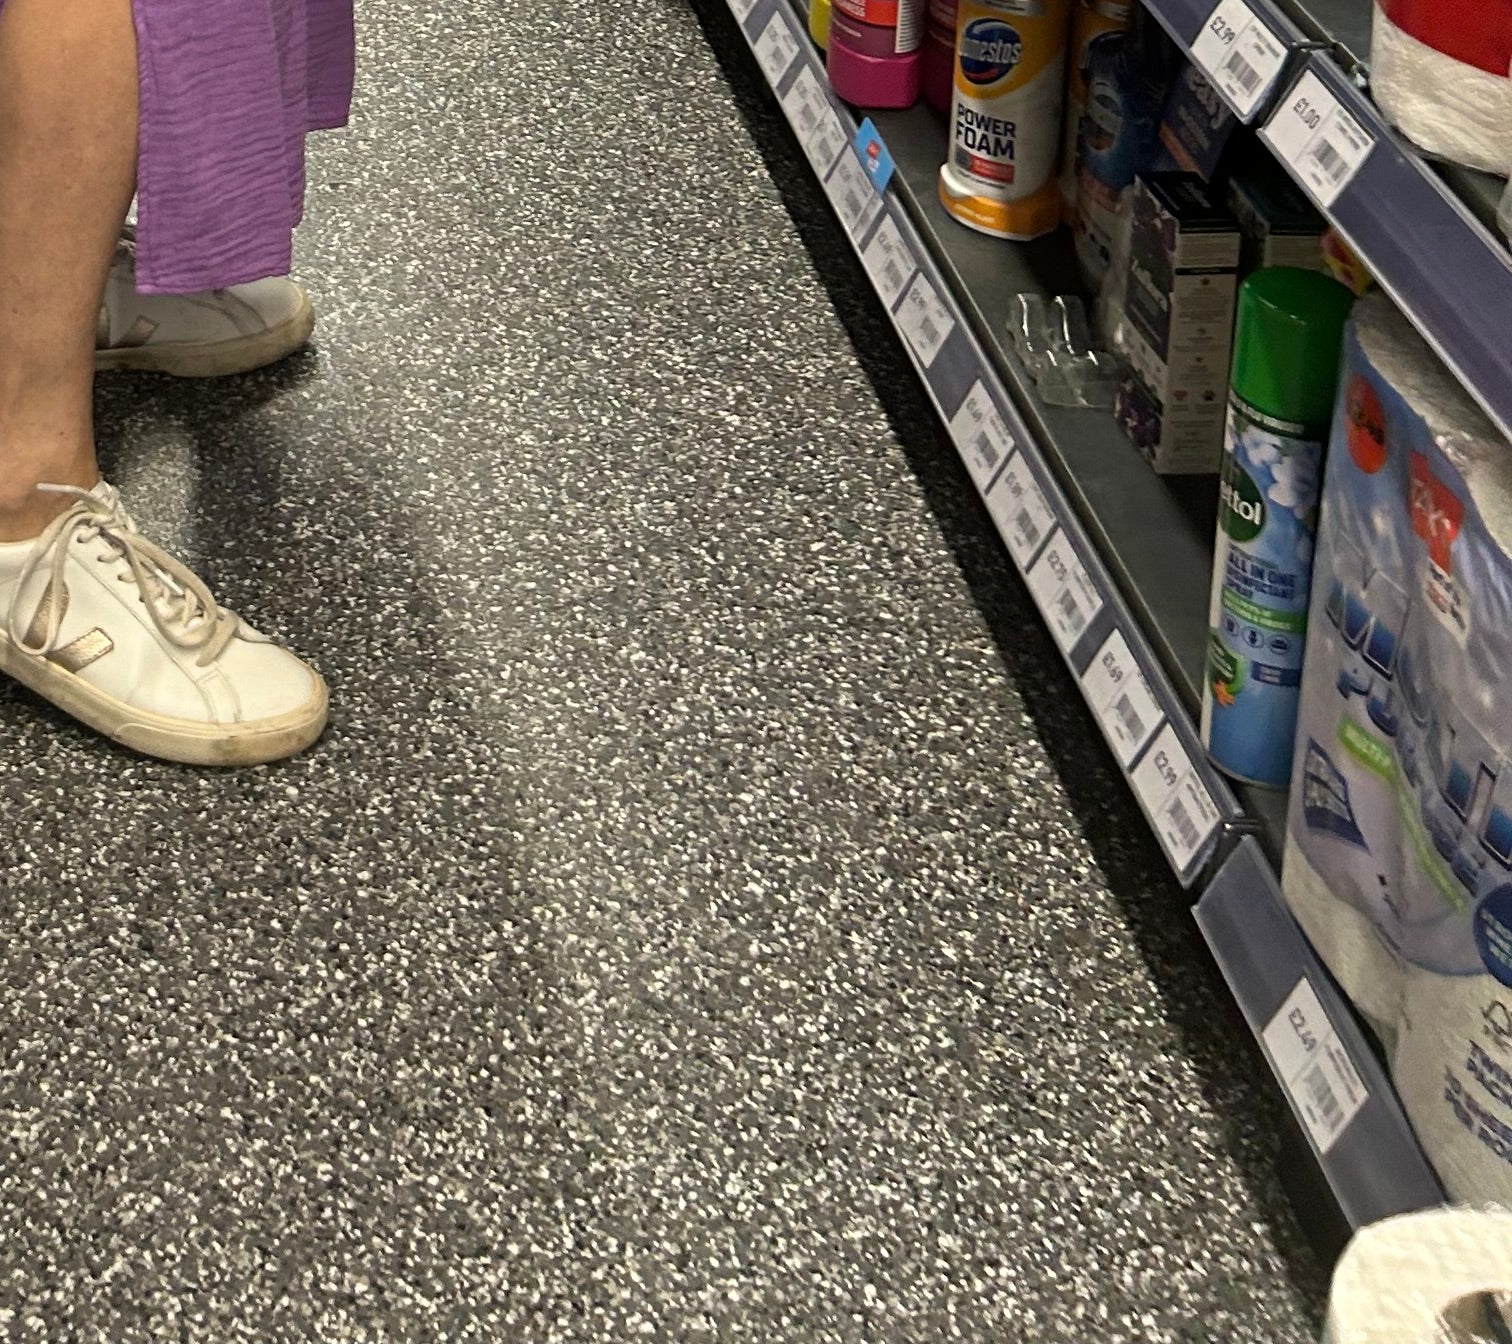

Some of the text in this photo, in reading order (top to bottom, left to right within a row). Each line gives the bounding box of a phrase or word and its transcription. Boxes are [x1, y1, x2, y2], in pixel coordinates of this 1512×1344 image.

[1208, 14, 1237, 47] £2.99
[956, 101, 1018, 139] POWER
[1291, 95, 1321, 130] £1.00
[955, 119, 1016, 162] FOAM
